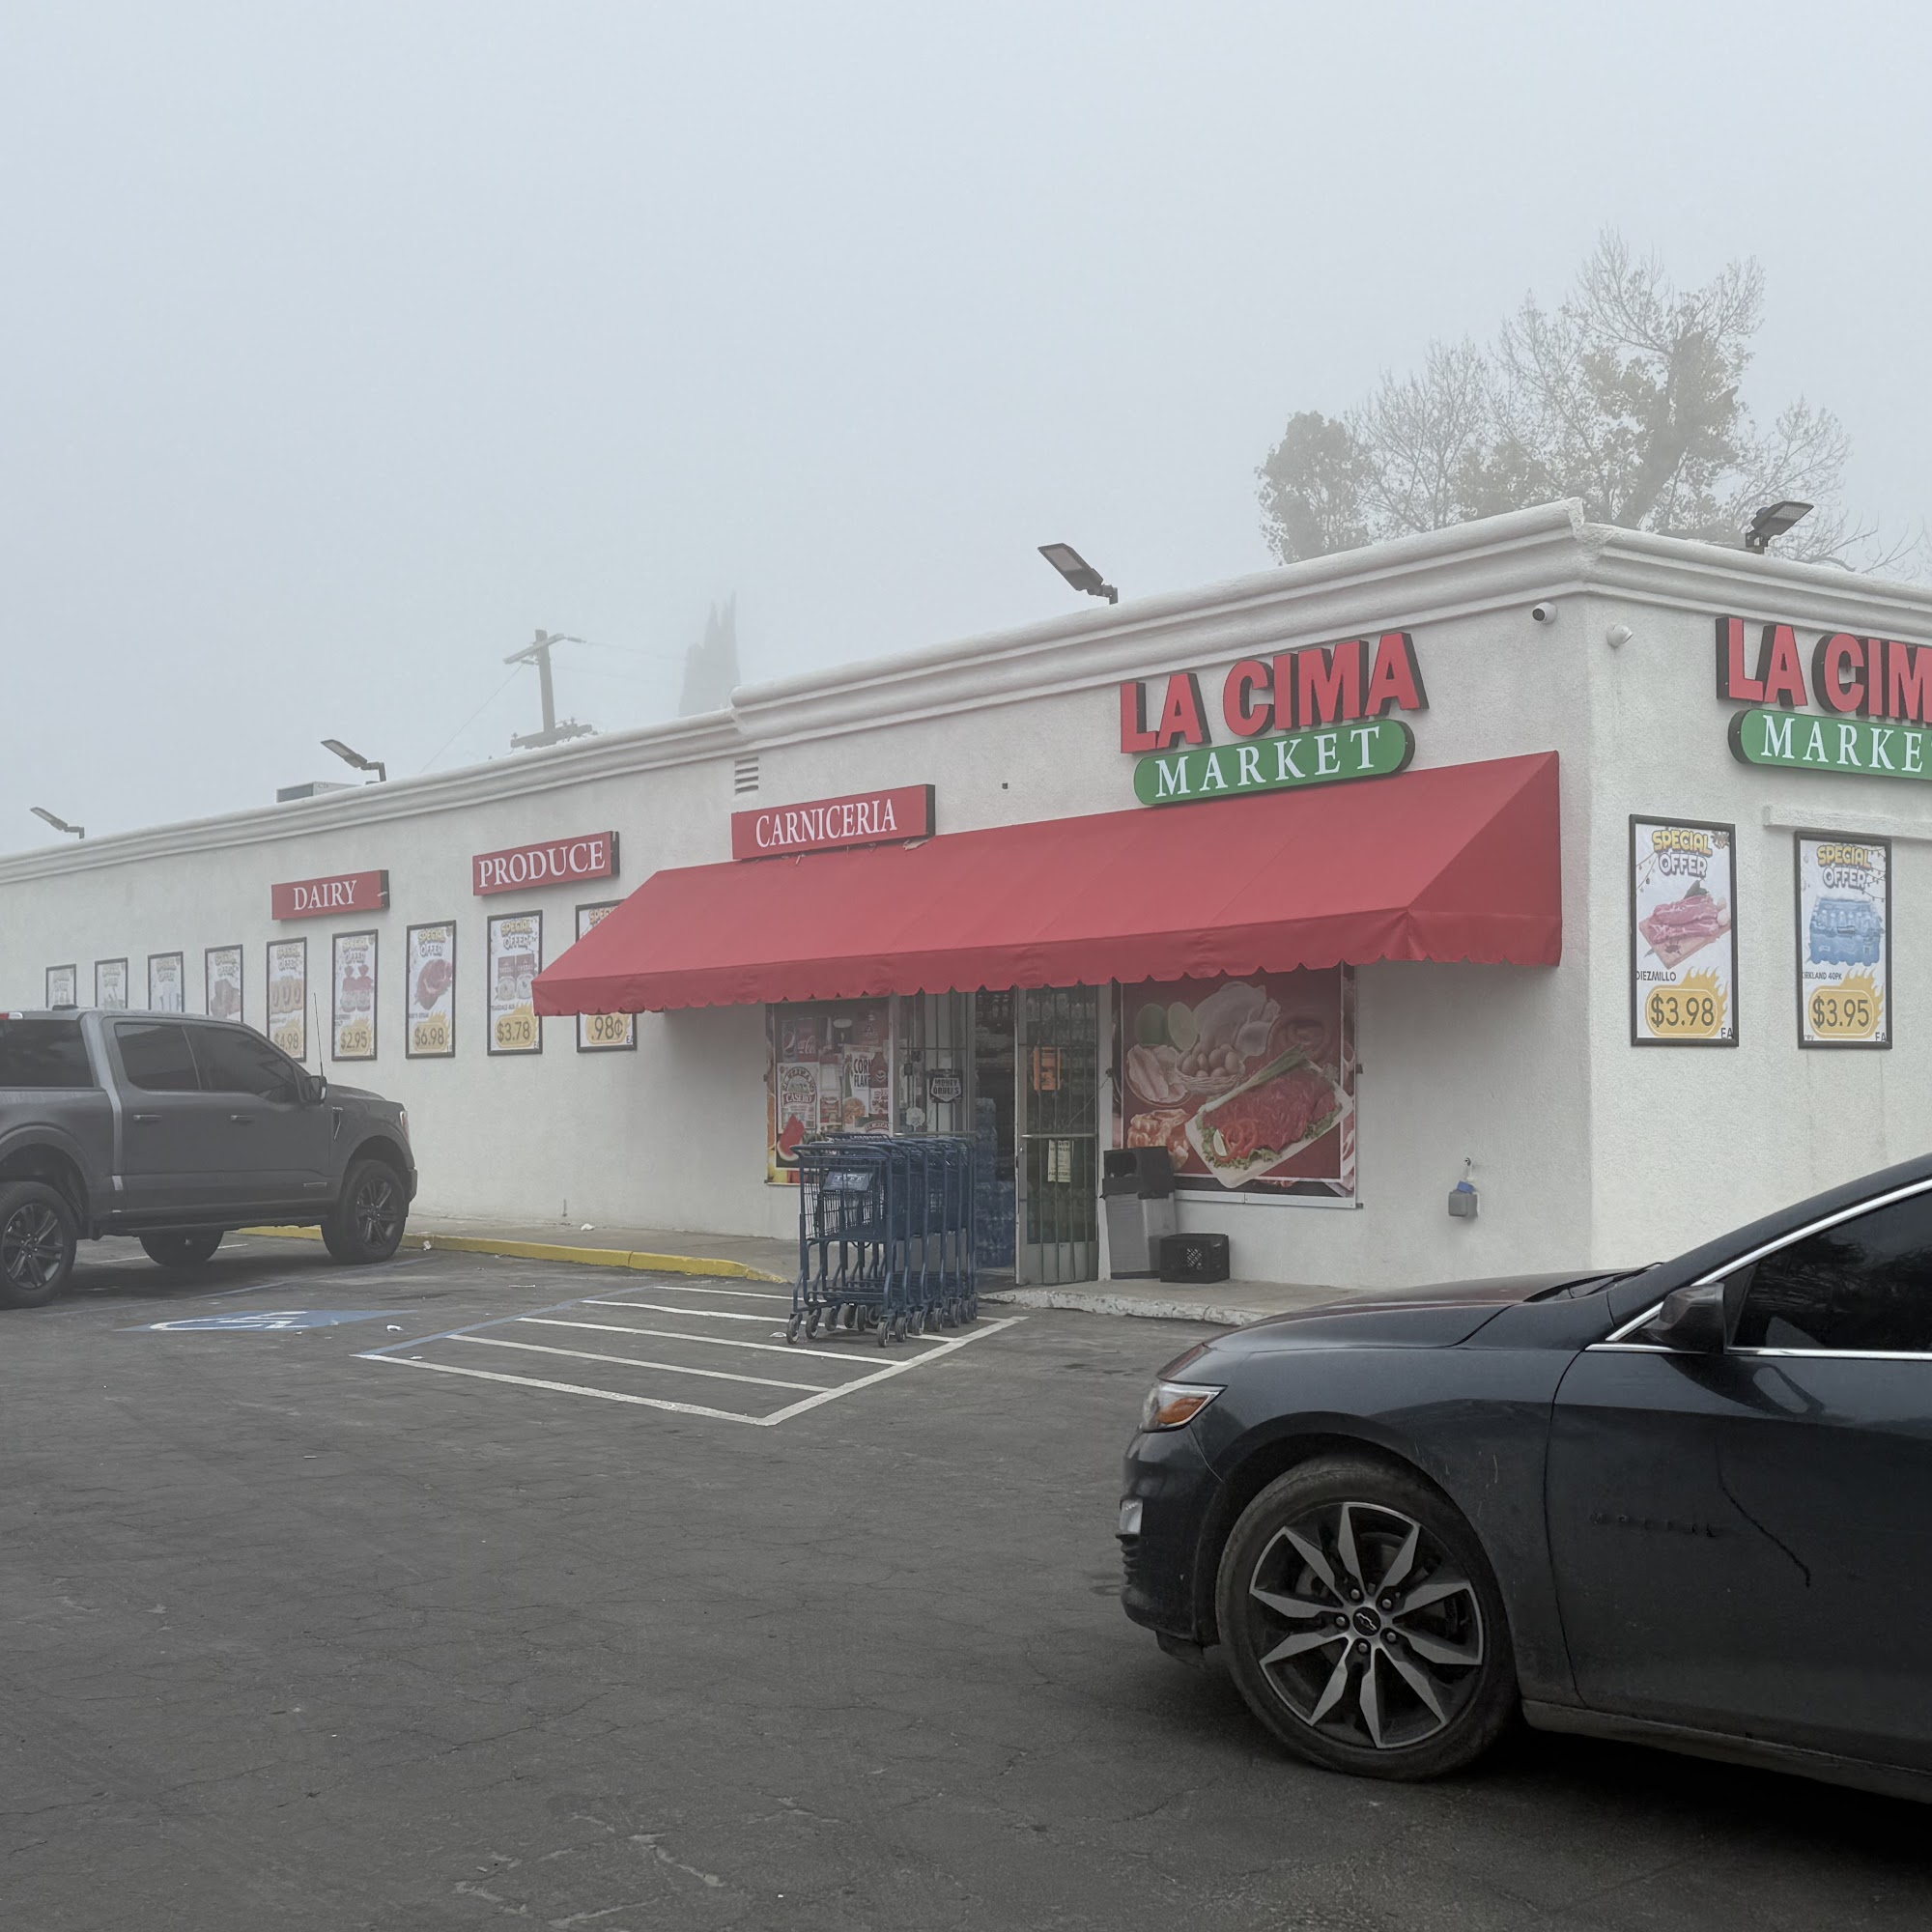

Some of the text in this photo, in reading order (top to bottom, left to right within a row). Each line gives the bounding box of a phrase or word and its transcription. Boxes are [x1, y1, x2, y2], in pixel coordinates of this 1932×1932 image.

[1716, 616, 1932, 723] LA CIM
[1121, 633, 1426, 753] LA CIMA
[1760, 714, 1932, 773] MARKE
[1155, 725, 1380, 797] MARKET
[755, 799, 897, 848] CARNICERIA
[1652, 829, 1713, 858] SPECIAL
[1817, 844, 1872, 870] SPECIAL
[479, 840, 606, 888] PRODUCE
[1659, 852, 1708, 878] OFFER
[1823, 867, 1866, 891] OFFER
[293, 880, 357, 911] DAIRY
[500, 919, 532, 937] SPECIAL
[503, 935, 531, 951] OFFER
[1635, 970, 1676, 981] DIEZMILLO
[1650, 993, 1715, 1028] $3.98
[1812, 995, 1869, 1029] $3.95
[340, 1031, 367, 1049] $2.95
[413, 1026, 444, 1046] $6.98
[497, 1020, 530, 1043] $3.78
[591, 1015, 624, 1040] .98¢
